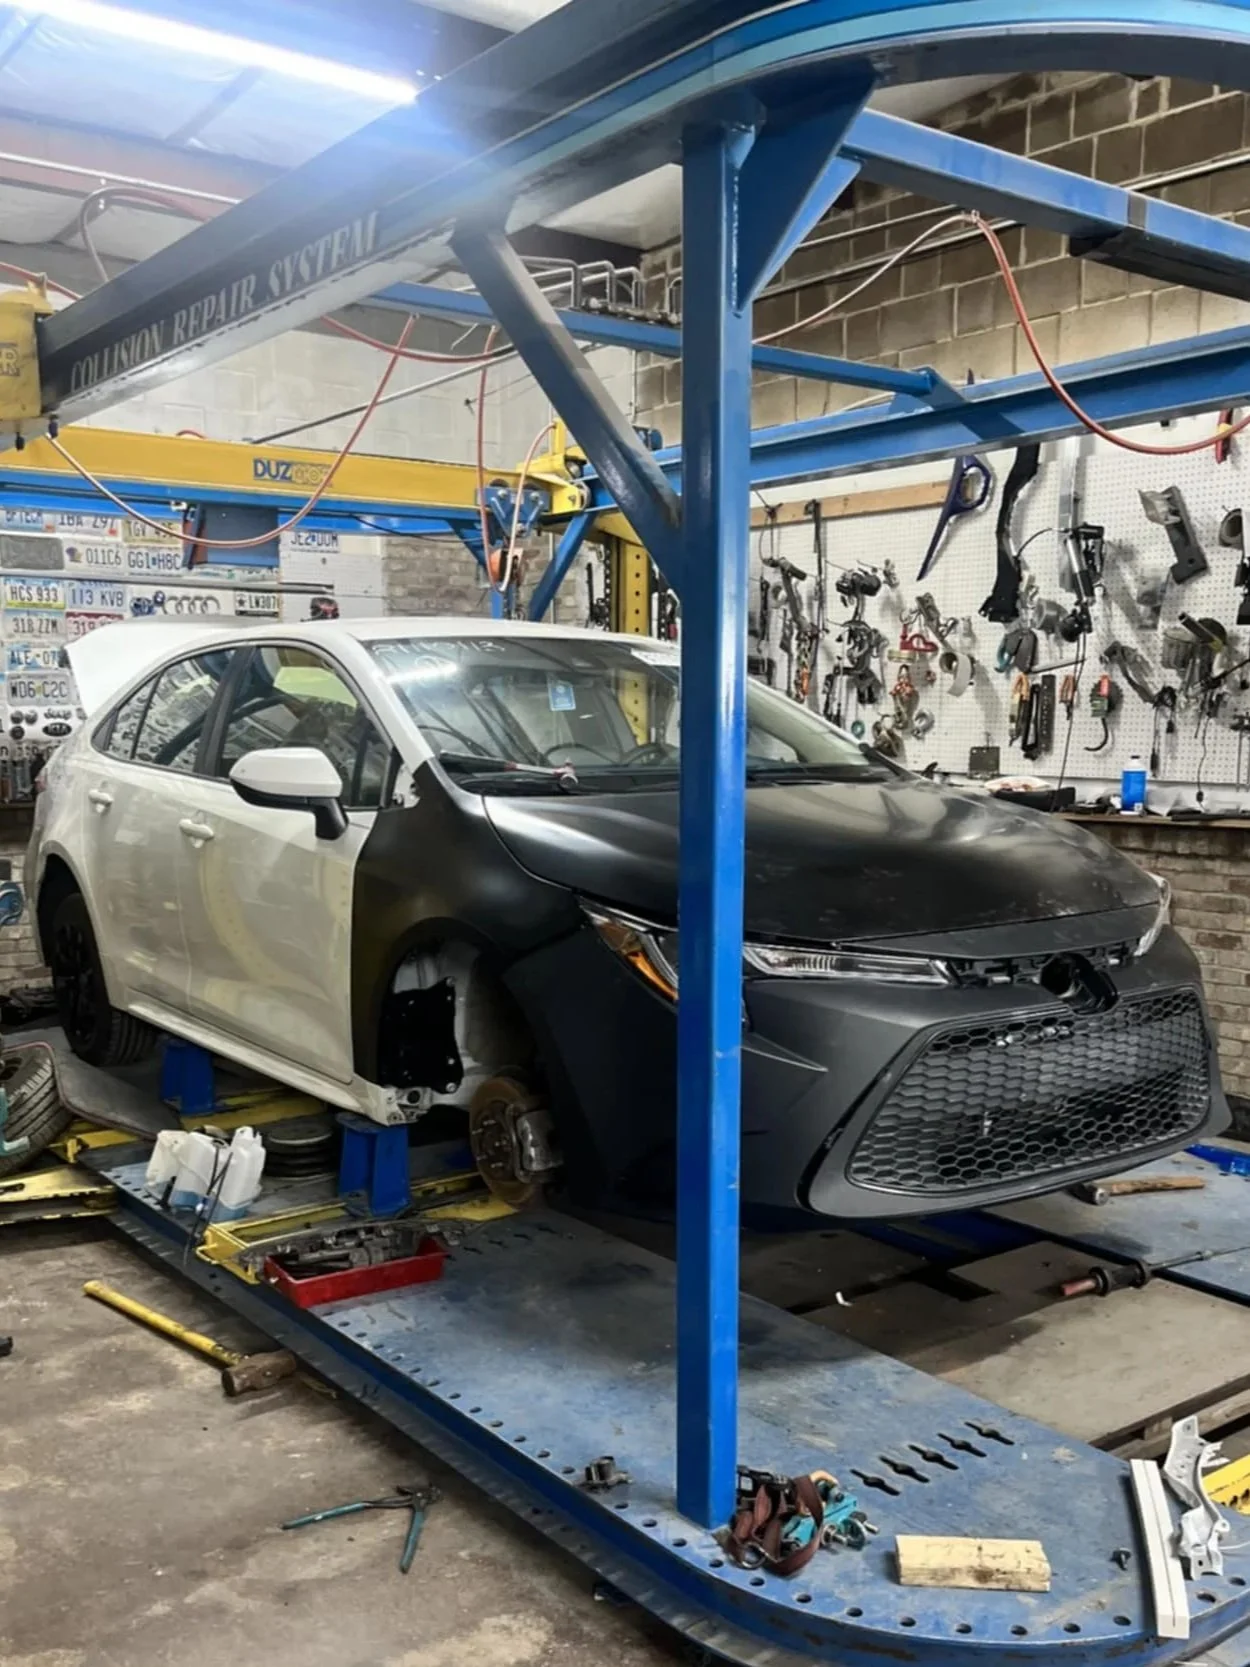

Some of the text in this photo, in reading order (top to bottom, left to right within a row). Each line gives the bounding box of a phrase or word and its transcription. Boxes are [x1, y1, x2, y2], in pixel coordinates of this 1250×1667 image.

[69, 209, 380, 394] COLLISION REPAIR SYSTEM
